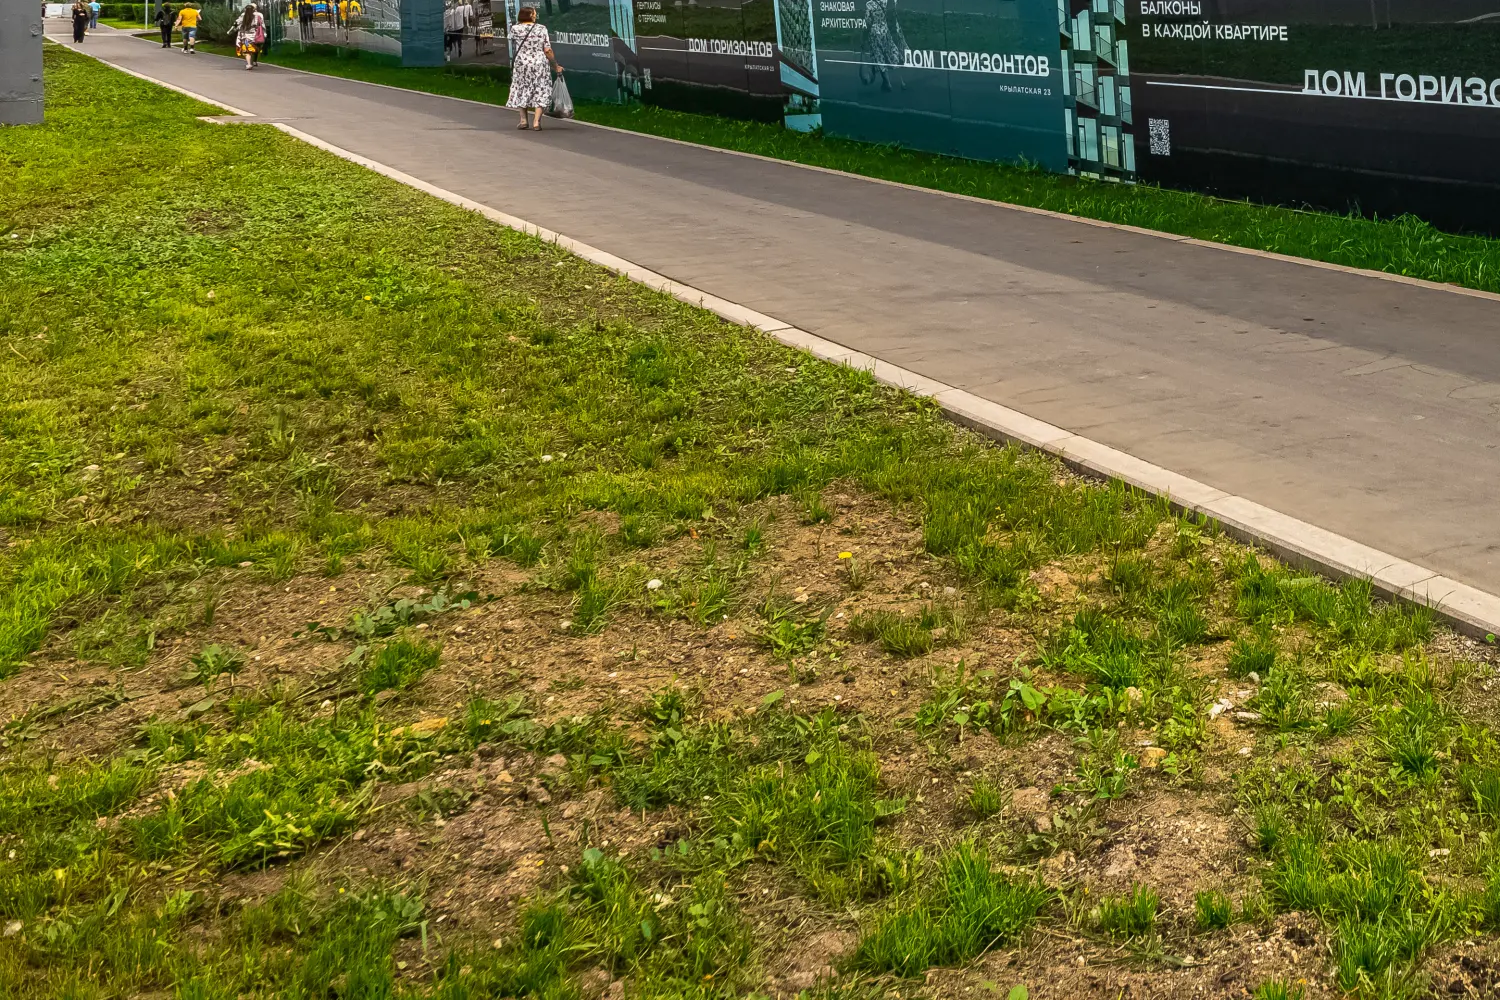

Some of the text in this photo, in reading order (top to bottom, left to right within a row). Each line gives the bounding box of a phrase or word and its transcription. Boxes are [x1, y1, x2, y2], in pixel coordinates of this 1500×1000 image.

[820, 1, 856, 12] ЗНАКОВАЯ
[1140, 1, 1201, 15] БАЛКОНЫ
[821, 17, 868, 29] АРХИТЕКТУРА
[1142, 20, 1289, 41] В КАЖДОЙ КВАРТИРЕ
[570, 32, 610, 47] ГОРИЗОНТОВ
[688, 38, 773, 57] ДОМ ГОРИЗОНТОВ
[904, 49, 1050, 77] ДОМ ГОРИЗОНТОВ
[1000, 85, 1052, 96] КРЫЛАТСКАЯ 23
[1302, 69, 1366, 98] ДОМ
